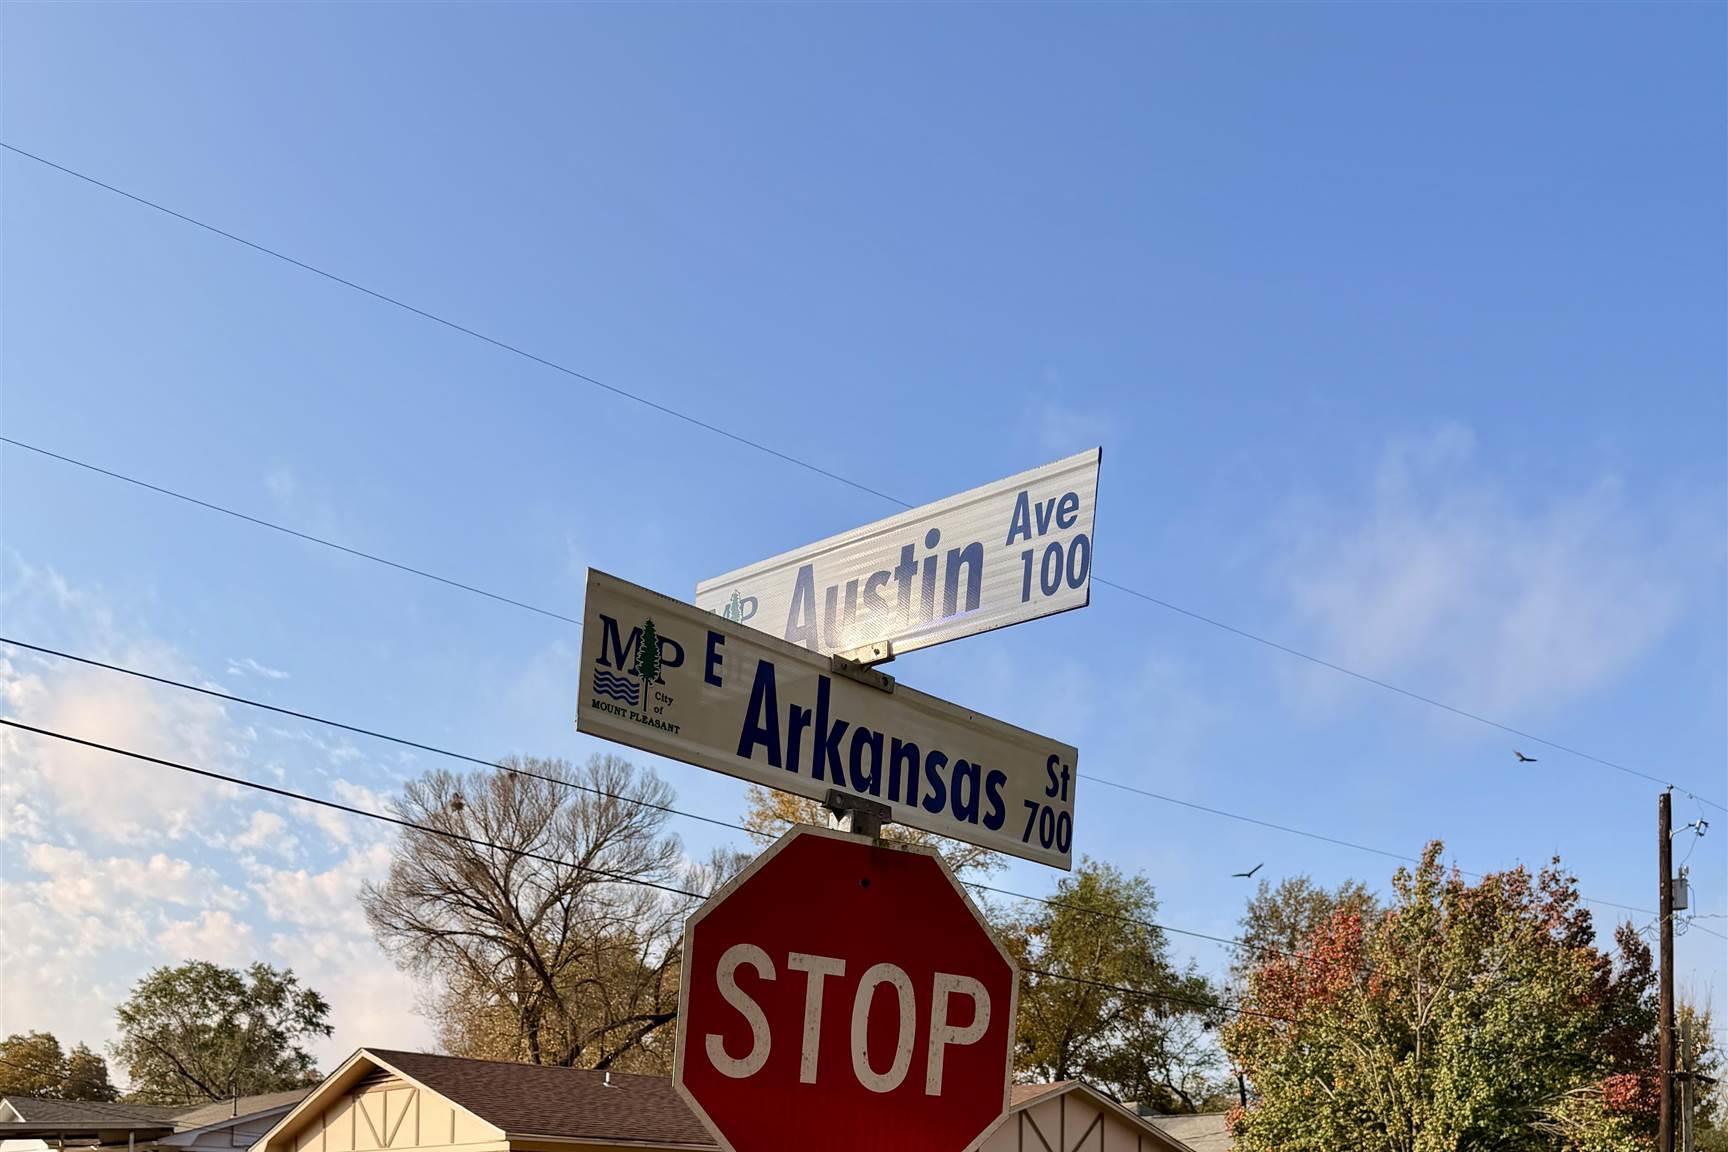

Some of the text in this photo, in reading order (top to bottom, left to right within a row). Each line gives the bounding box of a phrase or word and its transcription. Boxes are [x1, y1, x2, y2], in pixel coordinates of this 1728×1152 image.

[784, 490, 1079, 650] Austin Ave
[1021, 533, 1090, 603] 100
[592, 699, 680, 734] MOUNT PLEASANT
[654, 705, 664, 714] of
[655, 691, 674, 705] City
[705, 631, 1072, 831] E Arkansas St
[1023, 799, 1073, 855] 700
[705, 943, 991, 1096] STOP
